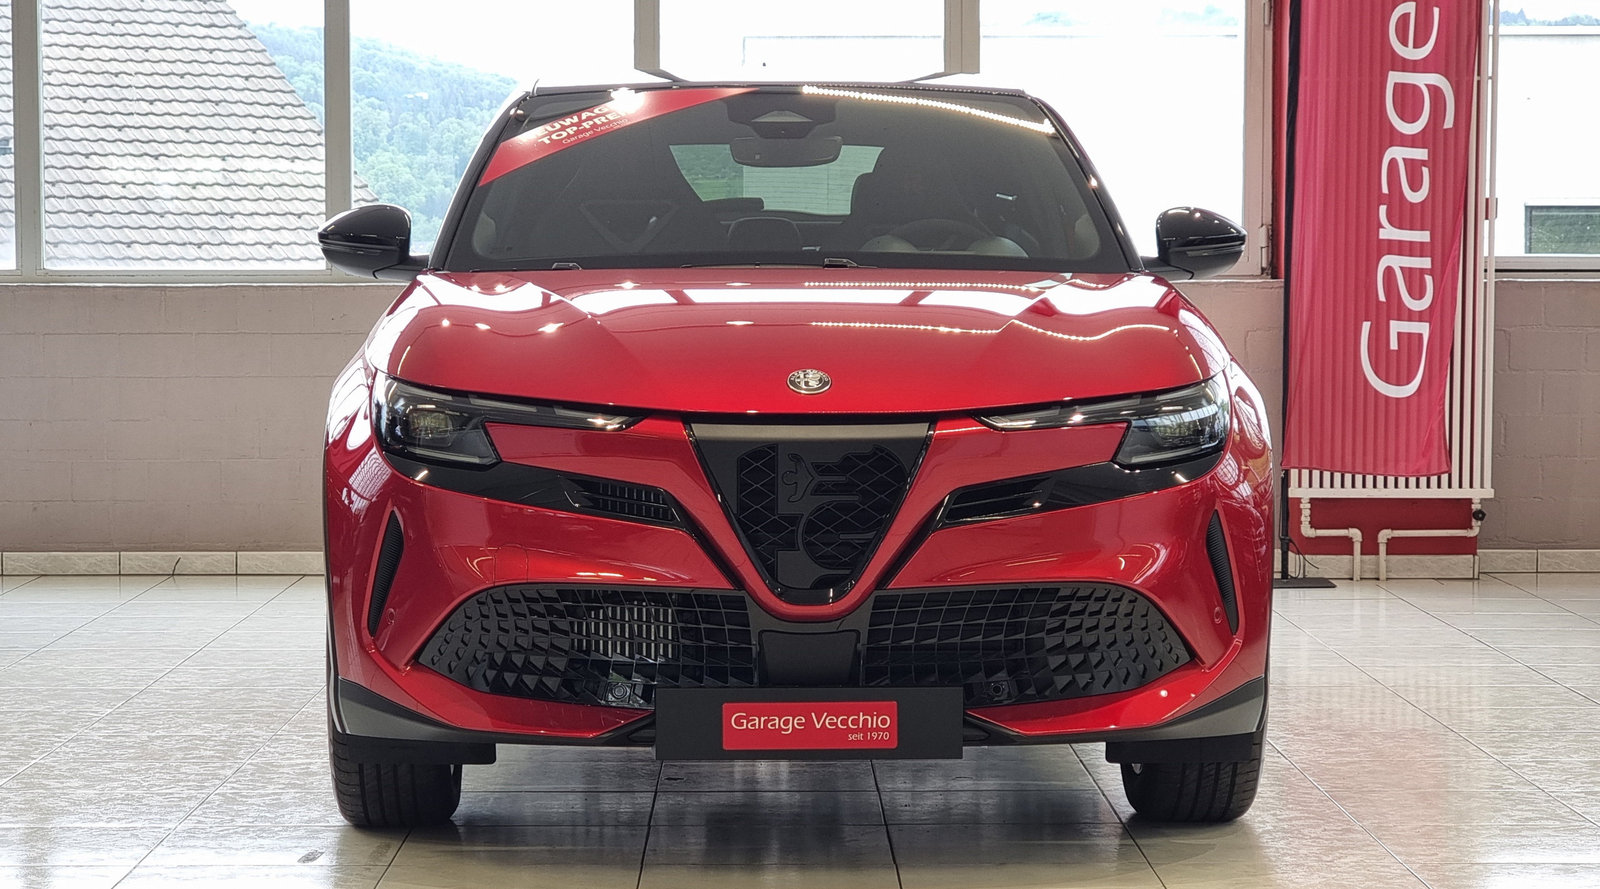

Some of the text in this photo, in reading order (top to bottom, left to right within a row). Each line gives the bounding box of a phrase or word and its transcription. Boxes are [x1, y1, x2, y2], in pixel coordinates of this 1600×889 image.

[528, 102, 618, 139] EUWAG
[538, 109, 628, 145] TOP-PRE
[562, 129, 594, 145] Garage
[594, 118, 629, 132] Vecchio
[1361, 1, 1455, 398] Garage
[731, 712, 891, 735] Garage Vecchio
[847, 731, 890, 741] seit 1970
